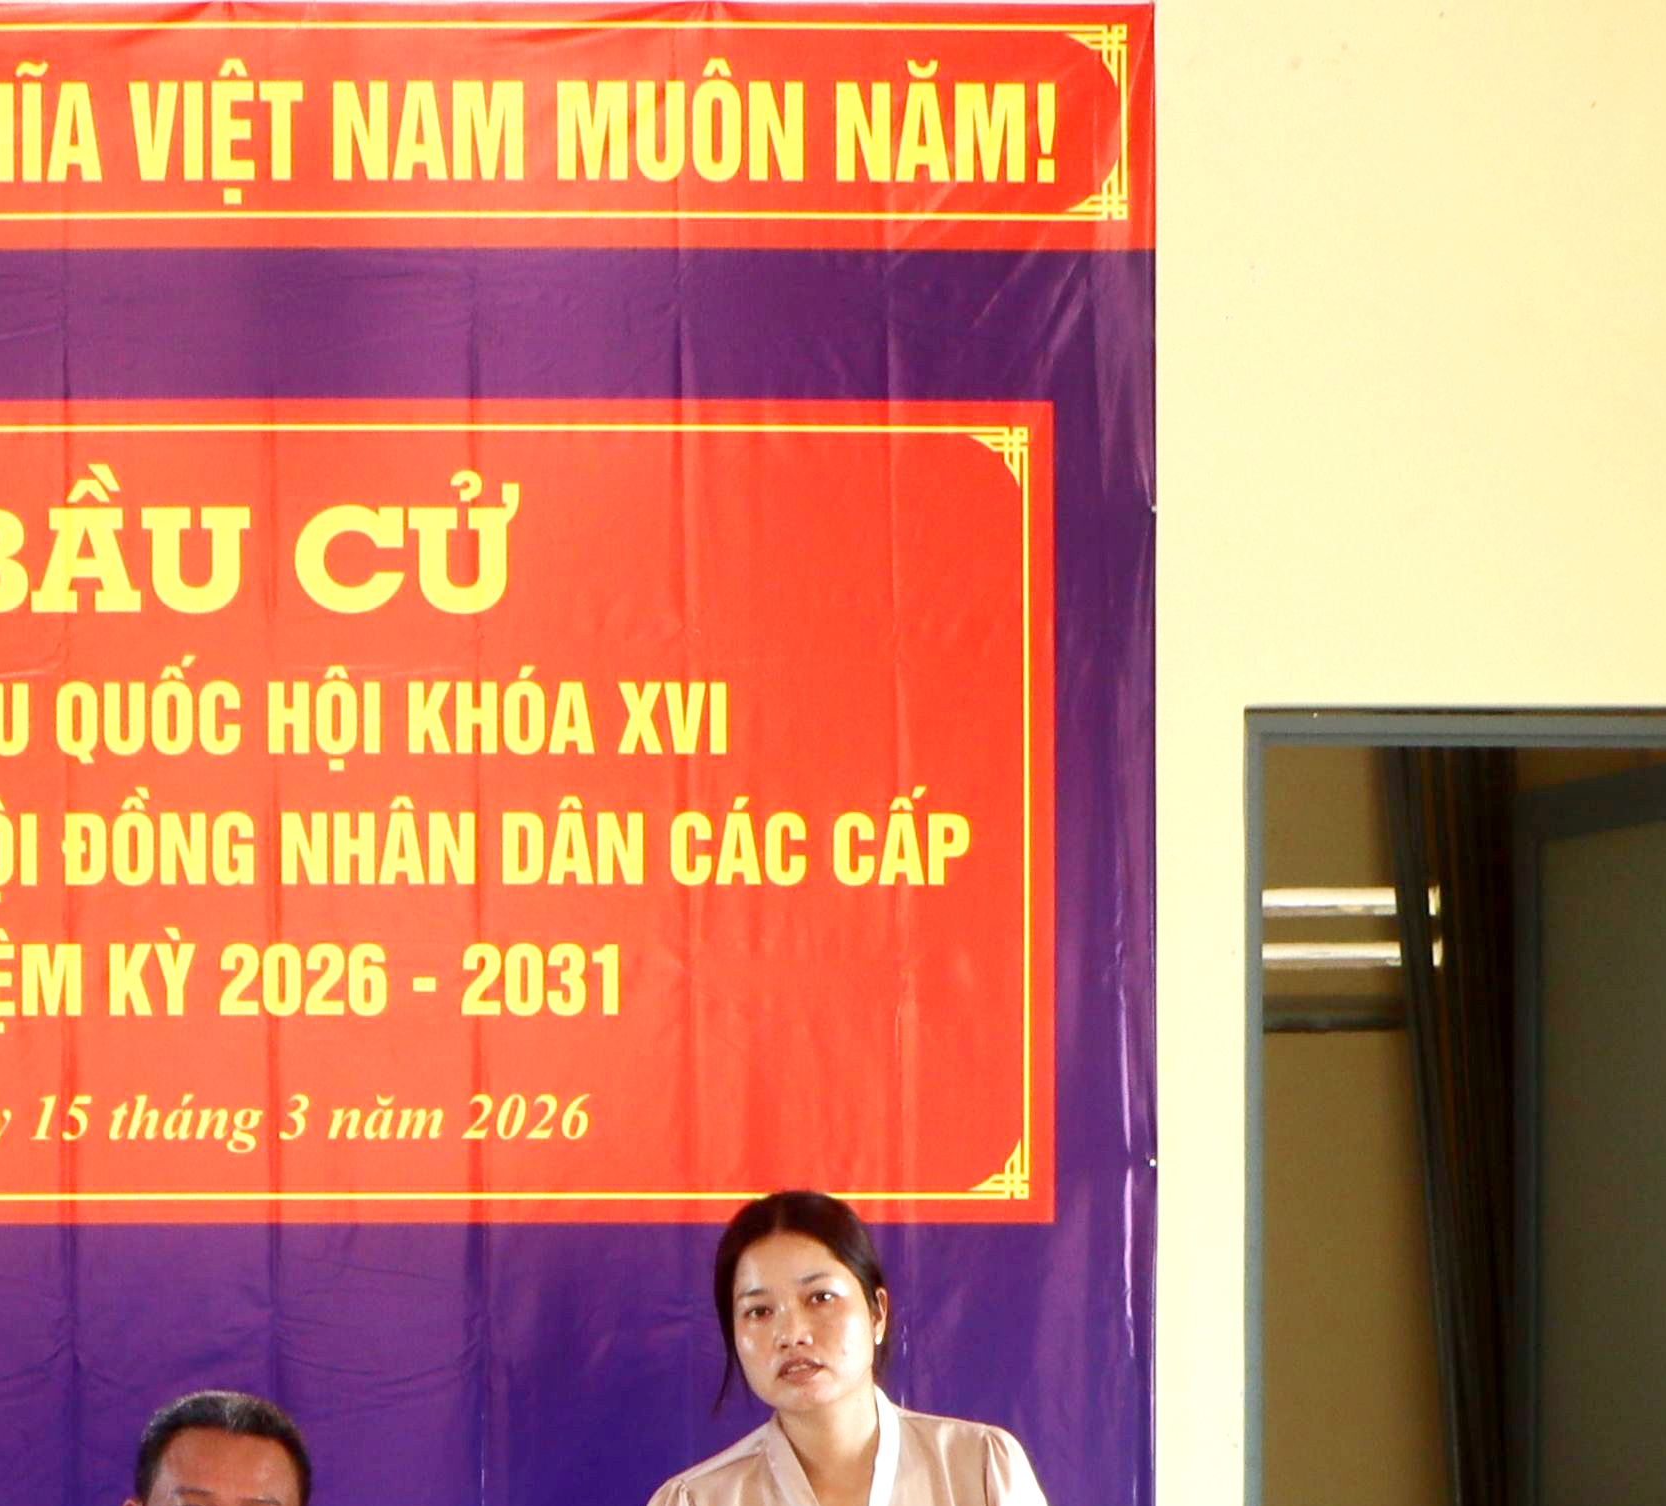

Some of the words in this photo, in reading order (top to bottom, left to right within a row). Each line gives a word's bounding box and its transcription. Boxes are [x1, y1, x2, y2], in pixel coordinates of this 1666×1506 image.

[128, 56, 305, 206] VIỆT
[332, 74, 530, 184] NAM
[555, 57, 804, 183] MUÔN
[836, 60, 1055, 183] NĂM!
[294, 468, 522, 615] CỬ
[56, 652, 243, 765] QUỐC
[267, 664, 385, 772] HỘI
[407, 664, 596, 756] KHÓA
[618, 680, 727, 756] XVI
[60, 784, 258, 887] ĐỒNG
[281, 792, 476, 887] NHÂN
[501, 794, 644, 886] DÂN
[670, 796, 807, 886] CÁC
[833, 786, 970, 886] CẤP
[109, 924, 199, 1018] KỲ
[219, 939, 391, 1018] 2026
[411, 976, 440, 994] -
[461, 941, 621, 1018] 2031
[30, 1094, 93, 1141] 15
[109, 1092, 264, 1154] tháng
[279, 1092, 312, 1140] 3
[328, 1094, 445, 1141] năm
[461, 1092, 591, 1140] 2026
